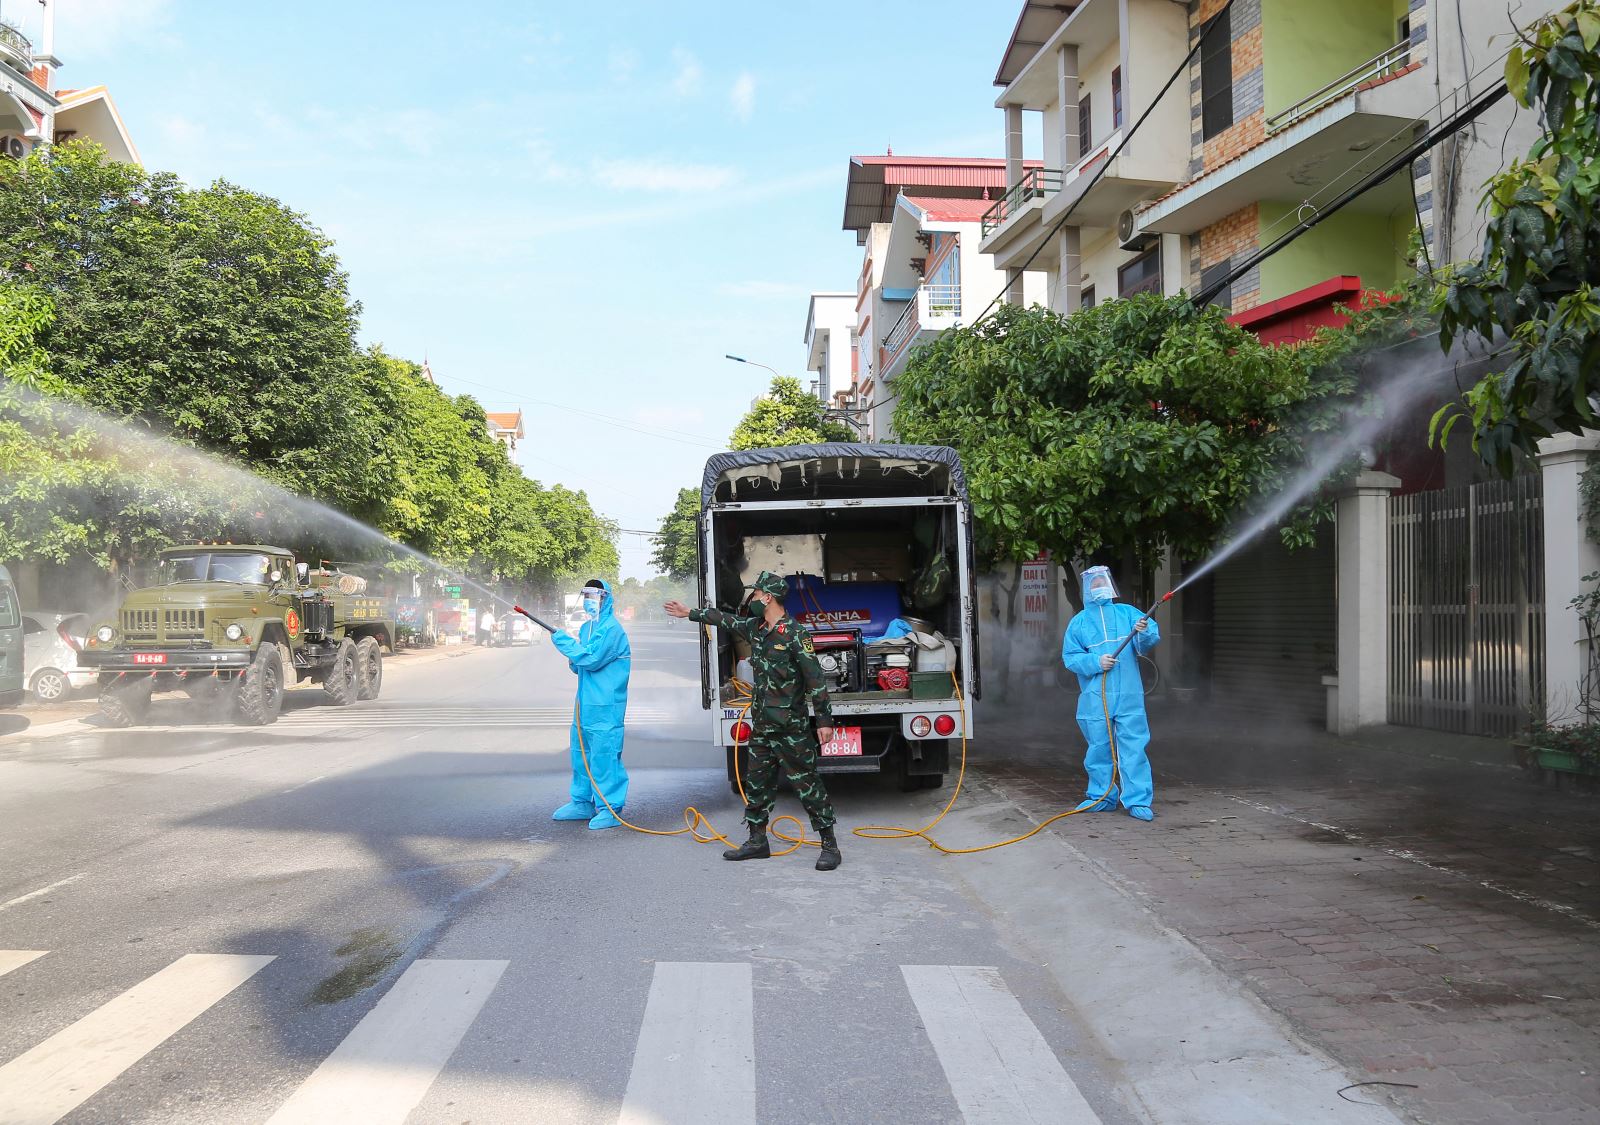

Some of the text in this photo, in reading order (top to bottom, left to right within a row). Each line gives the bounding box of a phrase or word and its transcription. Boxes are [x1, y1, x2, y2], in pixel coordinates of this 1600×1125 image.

[805, 611, 861, 622] SONHA
[724, 709, 746, 719] TM-2
[833, 727, 848, 741] KA
[824, 741, 858, 755] 68-84
